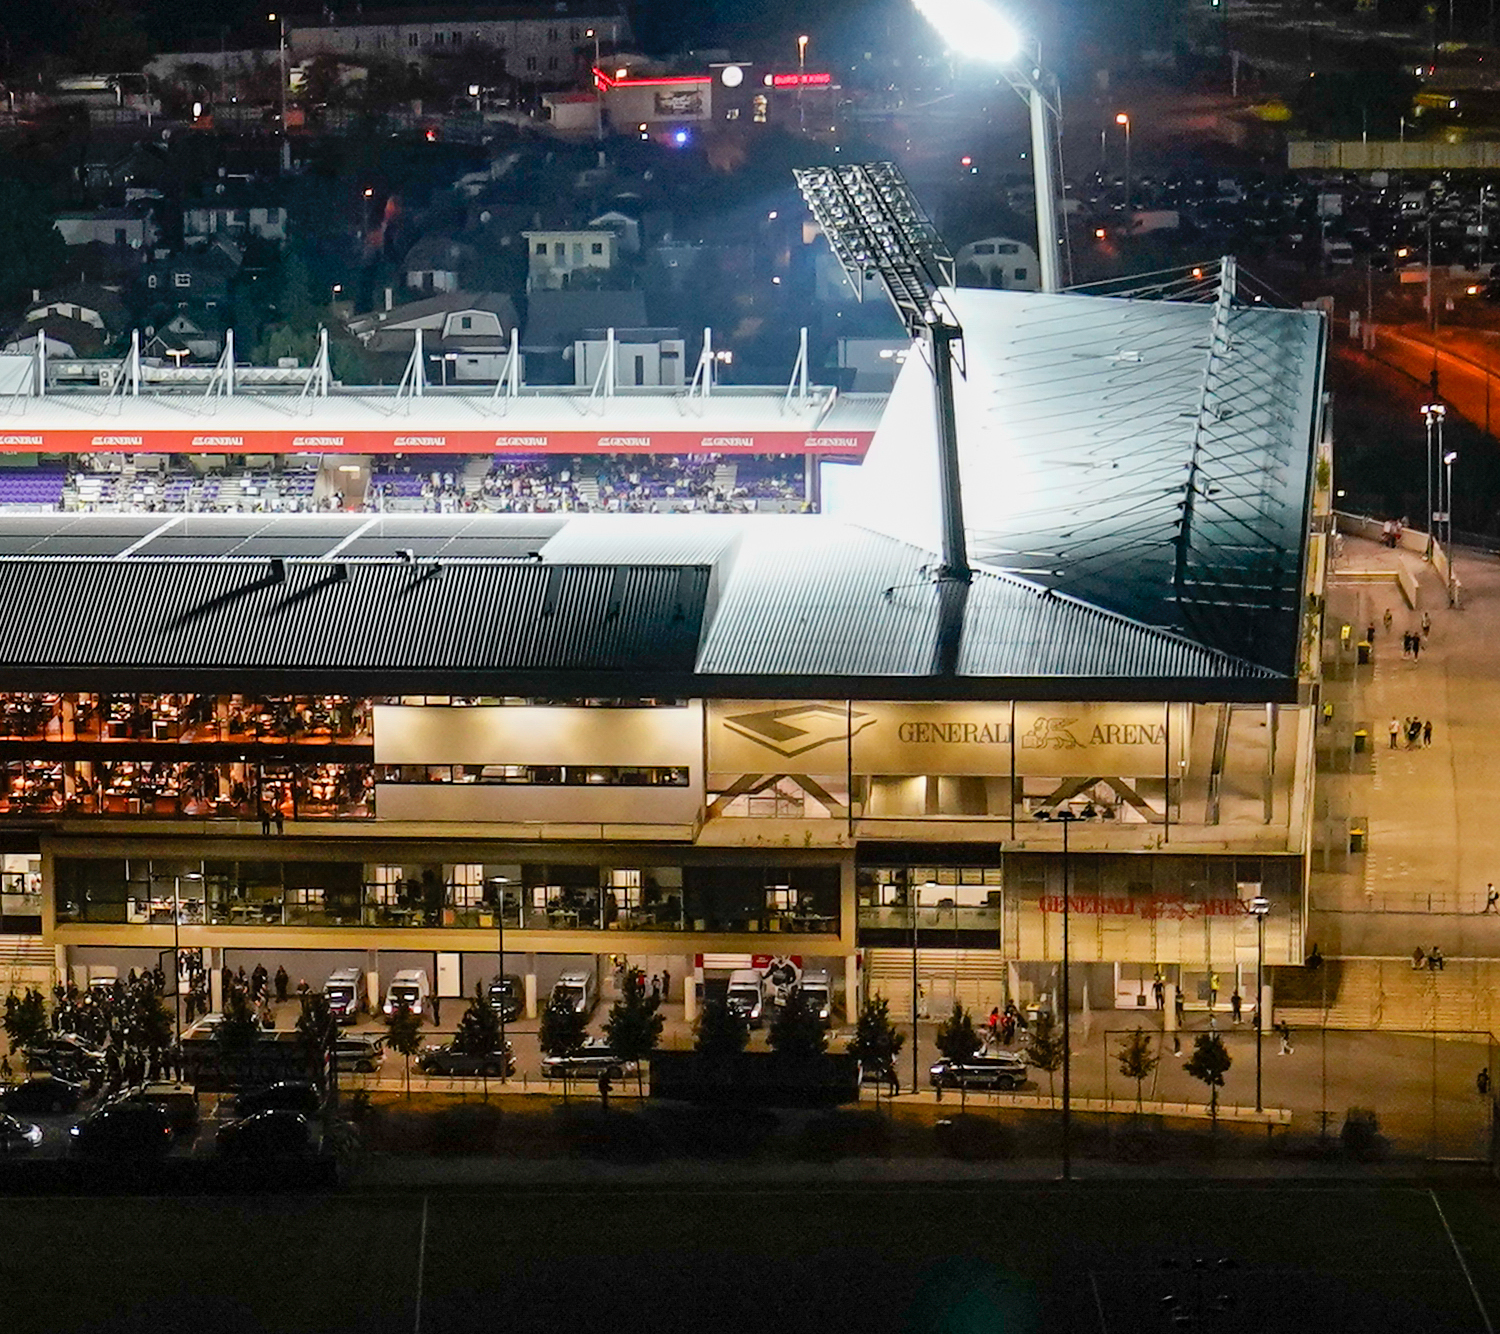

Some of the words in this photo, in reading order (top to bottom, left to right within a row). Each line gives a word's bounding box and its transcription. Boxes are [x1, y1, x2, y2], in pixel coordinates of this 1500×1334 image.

[898, 722, 1012, 744] GENERALI
[1089, 723, 1167, 745] ARENA
[1038, 895, 1134, 915] GENERALI
